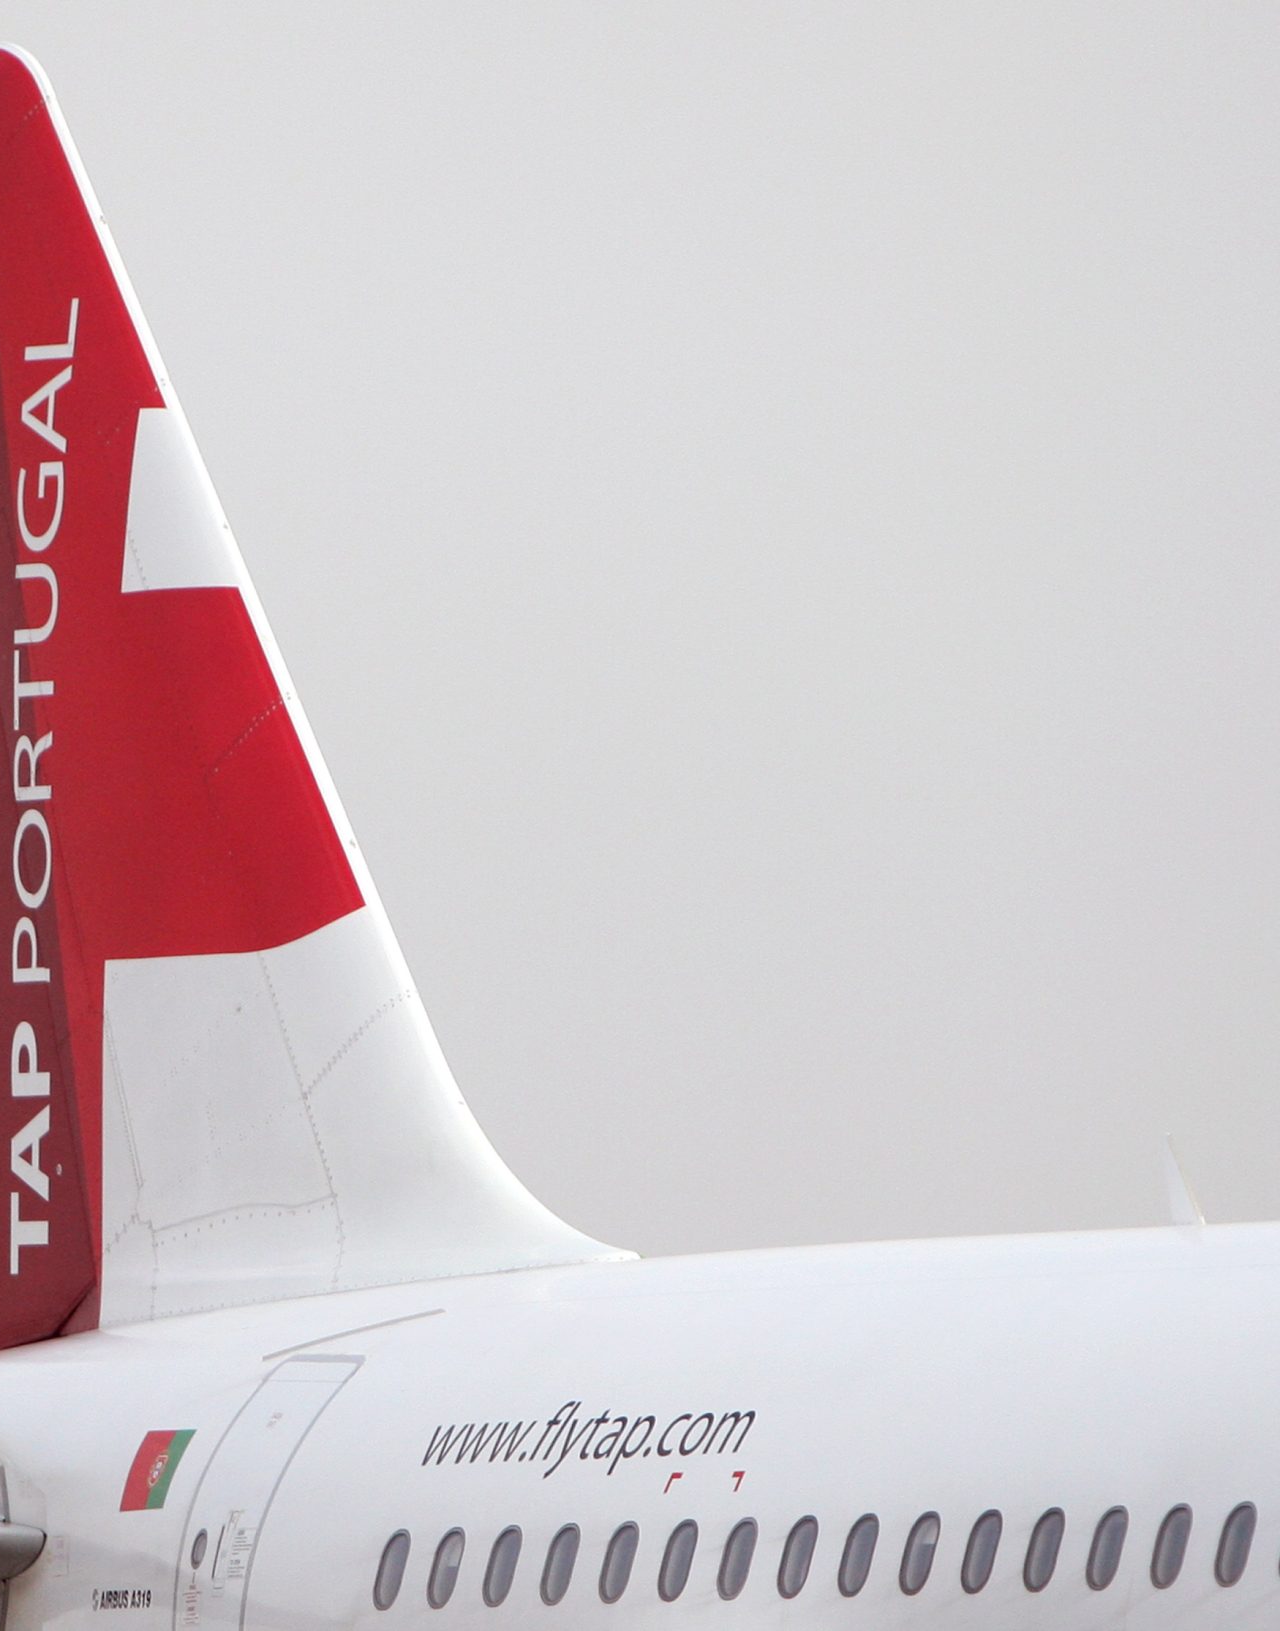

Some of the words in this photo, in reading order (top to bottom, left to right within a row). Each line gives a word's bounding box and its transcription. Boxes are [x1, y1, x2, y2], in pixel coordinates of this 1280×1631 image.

[11, 296, 80, 984] PORTUGAL
[9, 1020, 51, 1275] TAP
[421, 1400, 756, 1479] www.flytap.com
[99, 1590, 129, 1610] AIRBUS
[130, 1589, 152, 1609] A319
